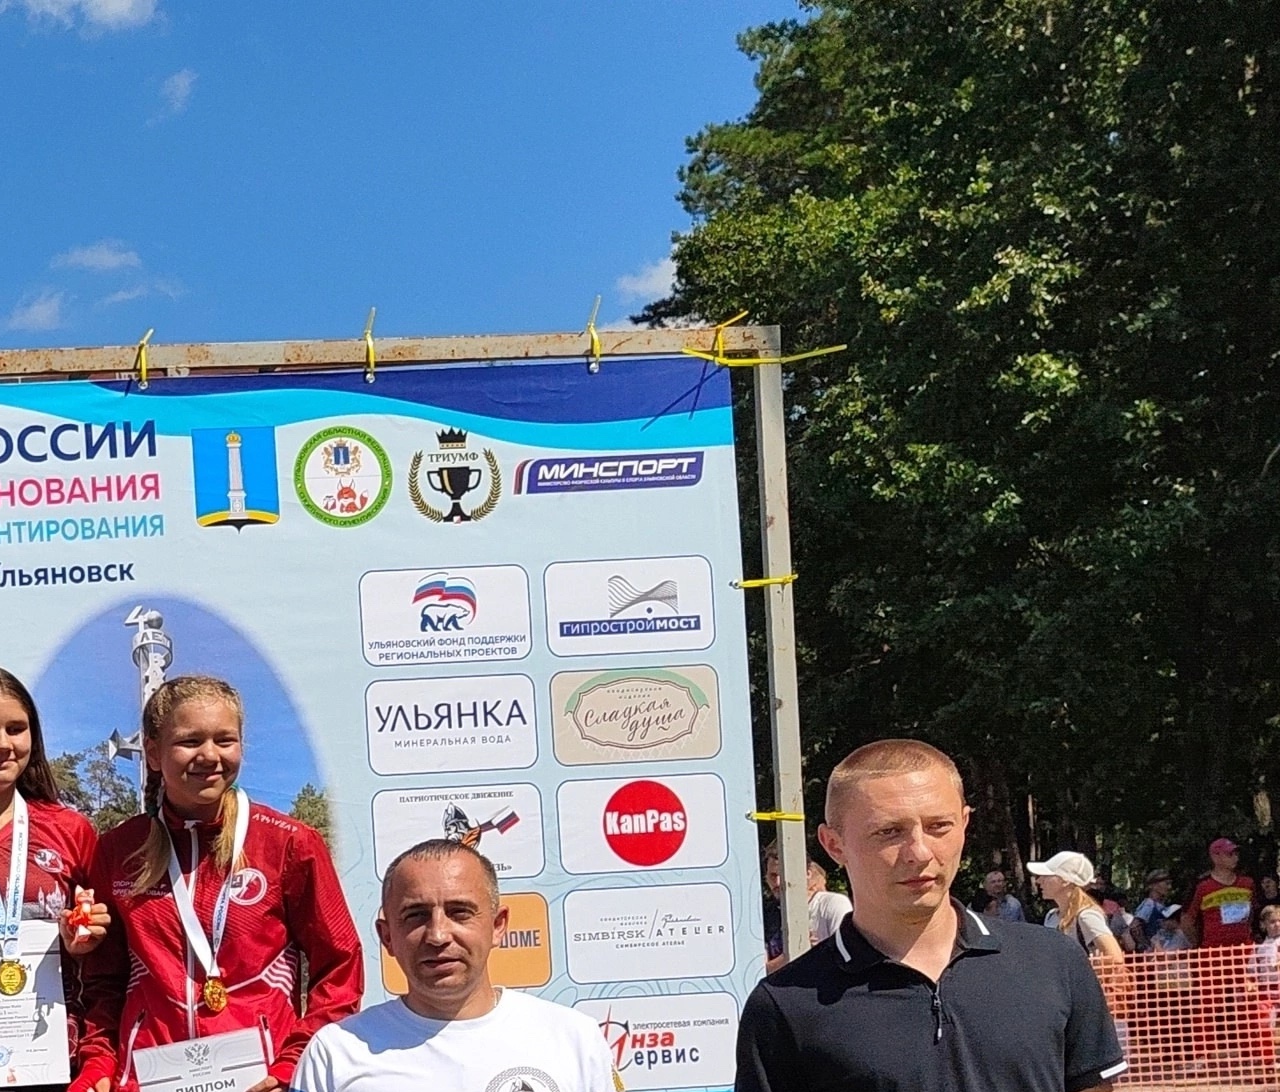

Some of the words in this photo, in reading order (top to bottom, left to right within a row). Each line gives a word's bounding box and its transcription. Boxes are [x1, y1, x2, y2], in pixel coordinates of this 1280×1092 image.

[427, 451, 480, 464] ТРИУМФ
[537, 456, 697, 479] МИНСПОРТ
[562, 614, 699, 638] гипростроймост
[368, 636, 436, 651] УЛЬЯНОВСКИЙ
[437, 636, 465, 648] ФОНД
[467, 633, 526, 647] ПОДДЕРЖКИ
[378, 648, 462, 662] РЕГИОНАЛЬНЫХ
[464, 646, 518, 658] ПРОЕКТОВ
[375, 699, 528, 735] УЛЬЯНКА
[584, 698, 672, 730] Сладкая
[627, 709, 685, 742] душа
[394, 737, 481, 749] МИНЕРАЛЬНАЯ
[484, 734, 511, 746] ВОДА
[399, 792, 470, 804] ПАТРИОТИЧЕСКОЕ
[471, 790, 515, 801] ДВИЖЕНИЕ
[606, 810, 686, 836] KanPas
[632, 1019, 691, 1031] электросетевая
[693, 1017, 730, 1028] компания
